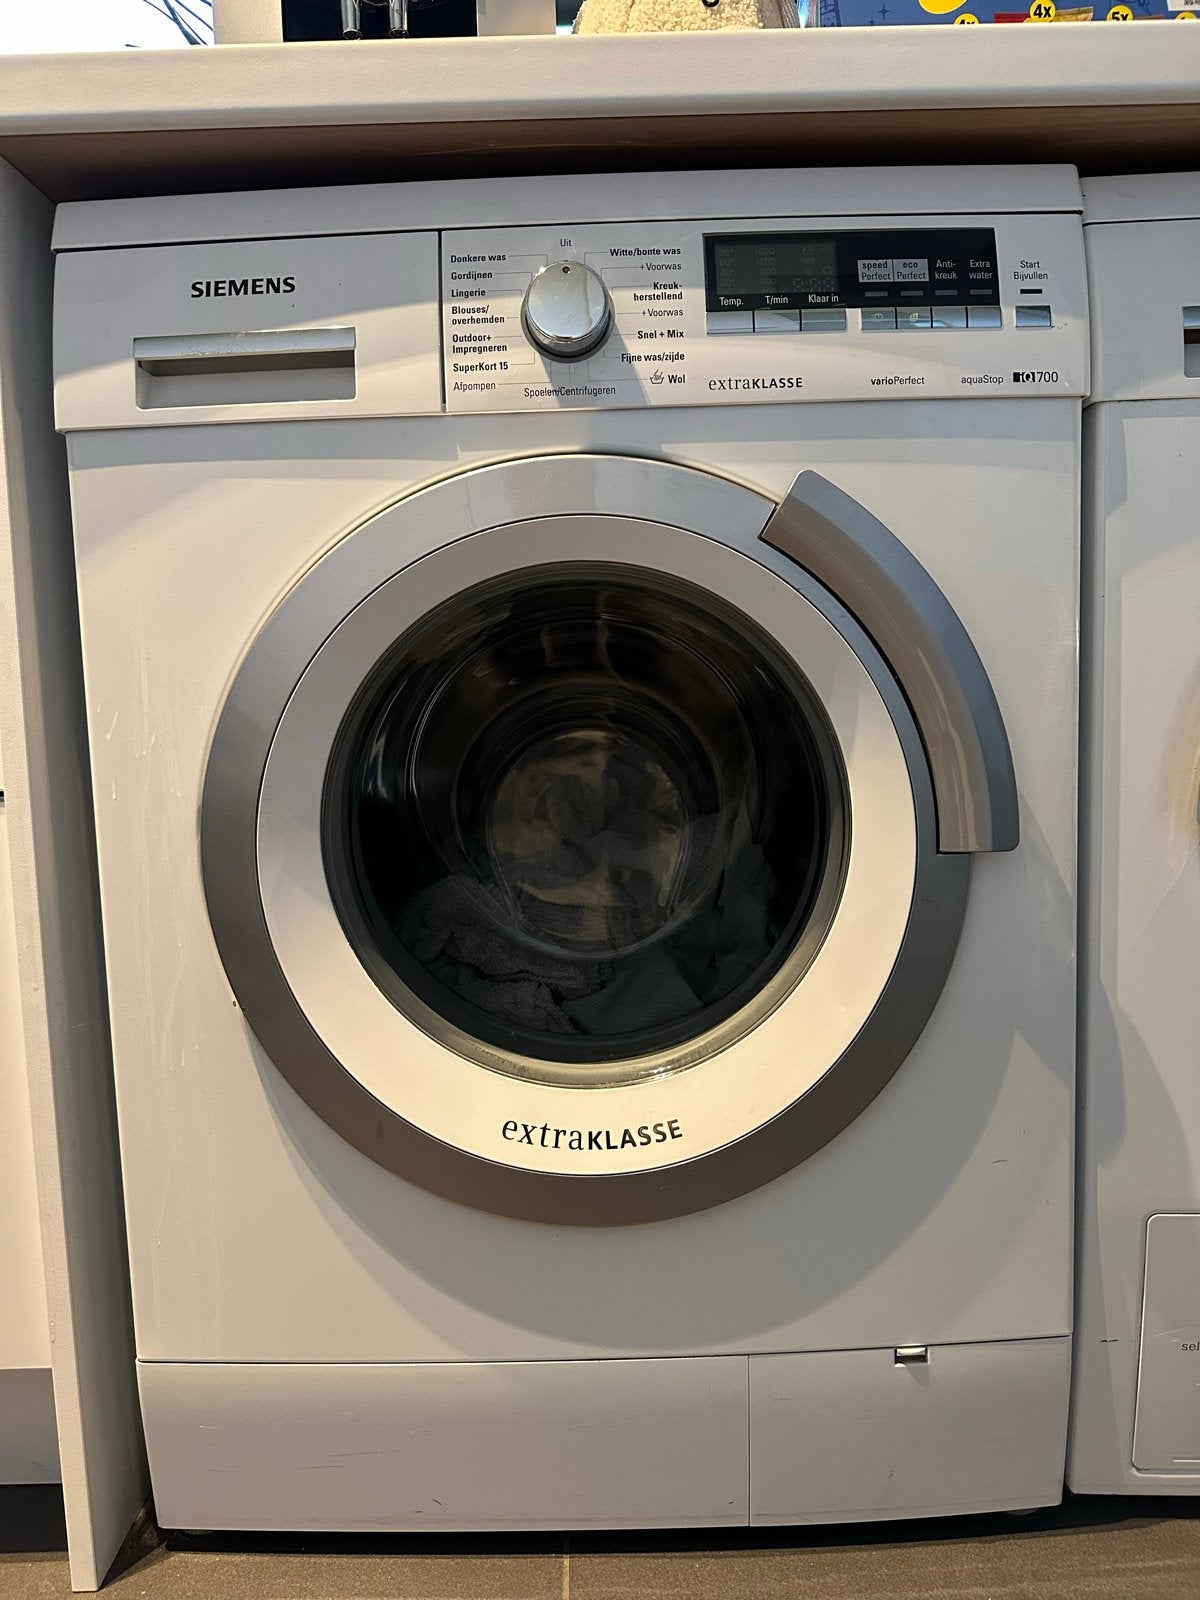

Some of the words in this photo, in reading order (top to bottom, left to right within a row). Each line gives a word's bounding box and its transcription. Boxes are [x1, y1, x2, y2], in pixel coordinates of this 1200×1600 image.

[1033, 3, 1052, 19] 4x
[560, 239, 572, 247] Uit
[609, 247, 661, 257] Witte/bonte
[450, 254, 487, 263] Donkere
[862, 261, 888, 270] speed
[936, 260, 956, 268] Anti-
[970, 260, 991, 268] Extra
[1020, 260, 1040, 269] Start
[451, 271, 493, 281] Gordijnen
[861, 271, 891, 280] Perfect
[897, 271, 926, 280] Perfect
[934, 270, 957, 279] kreuk
[969, 271, 993, 279] water
[1013, 271, 1048, 282] Bijvullen
[191, 276, 296, 298] SIEMENS
[653, 281, 682, 290] Kreuk-
[451, 288, 486, 298] Lingerie
[633, 291, 683, 301] herstellend
[719, 297, 744, 306] Temp.
[764, 295, 788, 304] T/min
[808, 294, 829, 303] Klaar
[831, 294, 839, 302] in
[451, 305, 489, 314] Blouses/
[451, 315, 505, 325] overhemden
[452, 334, 492, 342] Outdoor+
[637, 330, 657, 339] Snel
[667, 329, 684, 338] Mix
[452, 344, 507, 355] Impregneren
[621, 353, 642, 364] Fijne
[643, 353, 685, 362] was/zijde
[453, 362, 497, 373] SuperKort
[499, 362, 509, 370] 15
[668, 374, 686, 384] Wol
[708, 377, 803, 391] extraKLASSE
[870, 375, 925, 385] varioPerfect
[961, 374, 1004, 385] aquaStop
[453, 382, 496, 392] Afpompen
[524, 386, 616, 398] Spoelen/Centrifugeren
[502, 1118, 683, 1151] extraKLASSE
